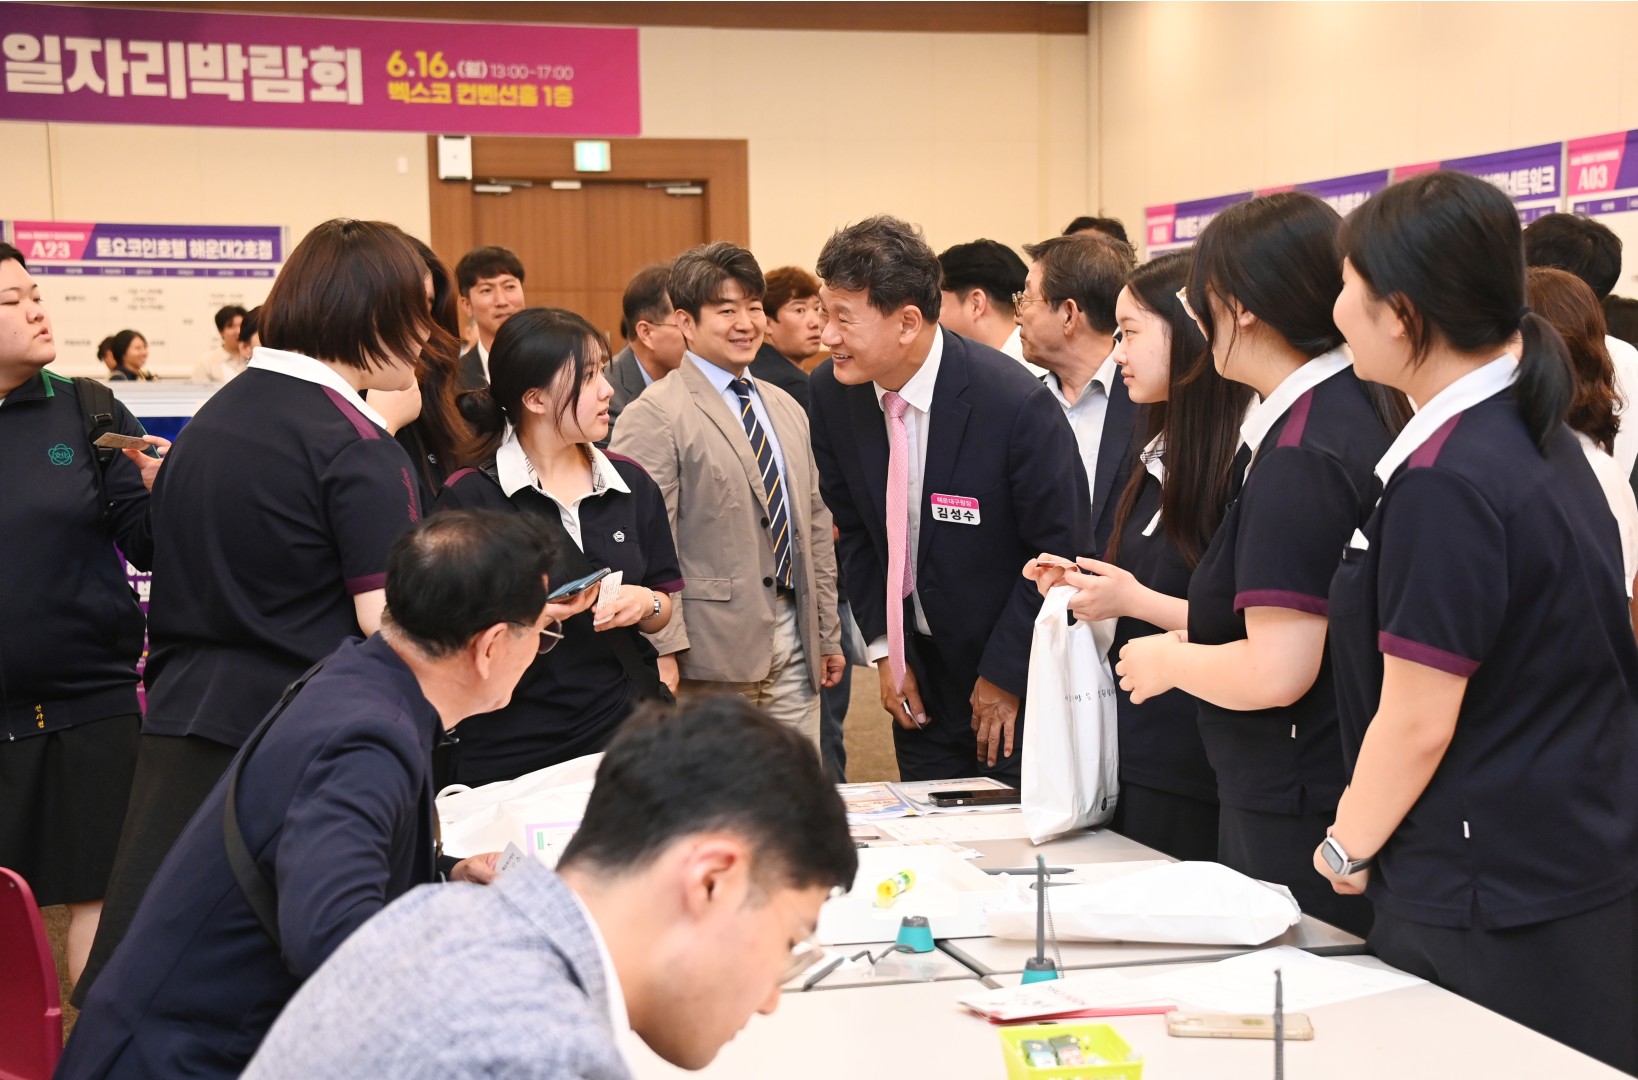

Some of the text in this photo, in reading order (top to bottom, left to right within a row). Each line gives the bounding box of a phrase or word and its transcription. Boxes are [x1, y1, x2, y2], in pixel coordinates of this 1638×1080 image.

[2, 33, 364, 105] 일자리박람회
[387, 81, 574, 107] 벡스코 컨벤션홀 1층
[1578, 164, 1609, 192] A03
[30, 240, 71, 259] A23
[96, 237, 273, 260] 토요코인호텔 해운대2호점
[937, 507, 975, 522] 김성수
